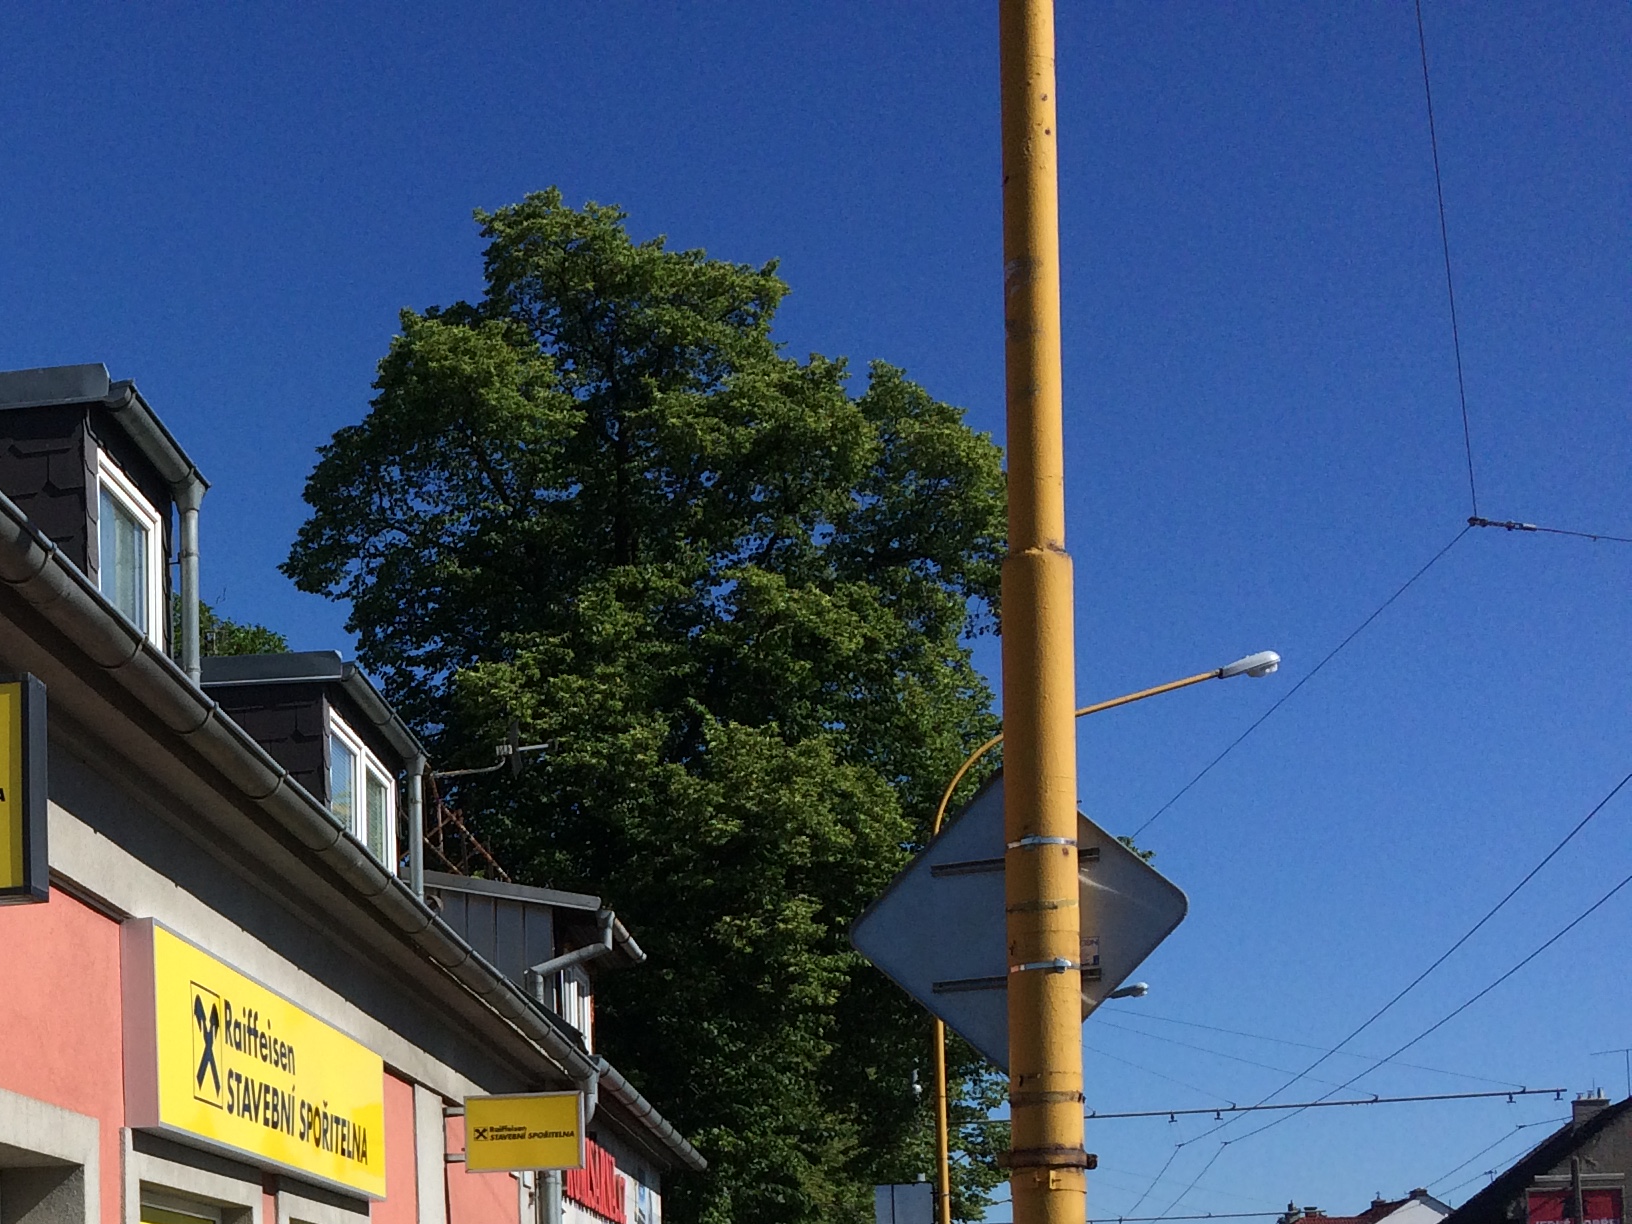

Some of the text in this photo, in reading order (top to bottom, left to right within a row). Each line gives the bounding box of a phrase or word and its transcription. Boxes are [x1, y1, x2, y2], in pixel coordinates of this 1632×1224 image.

[224, 998, 296, 1075] Raiffeisen
[227, 1067, 368, 1166] STAVEBNÍ SPOŘITELNA
